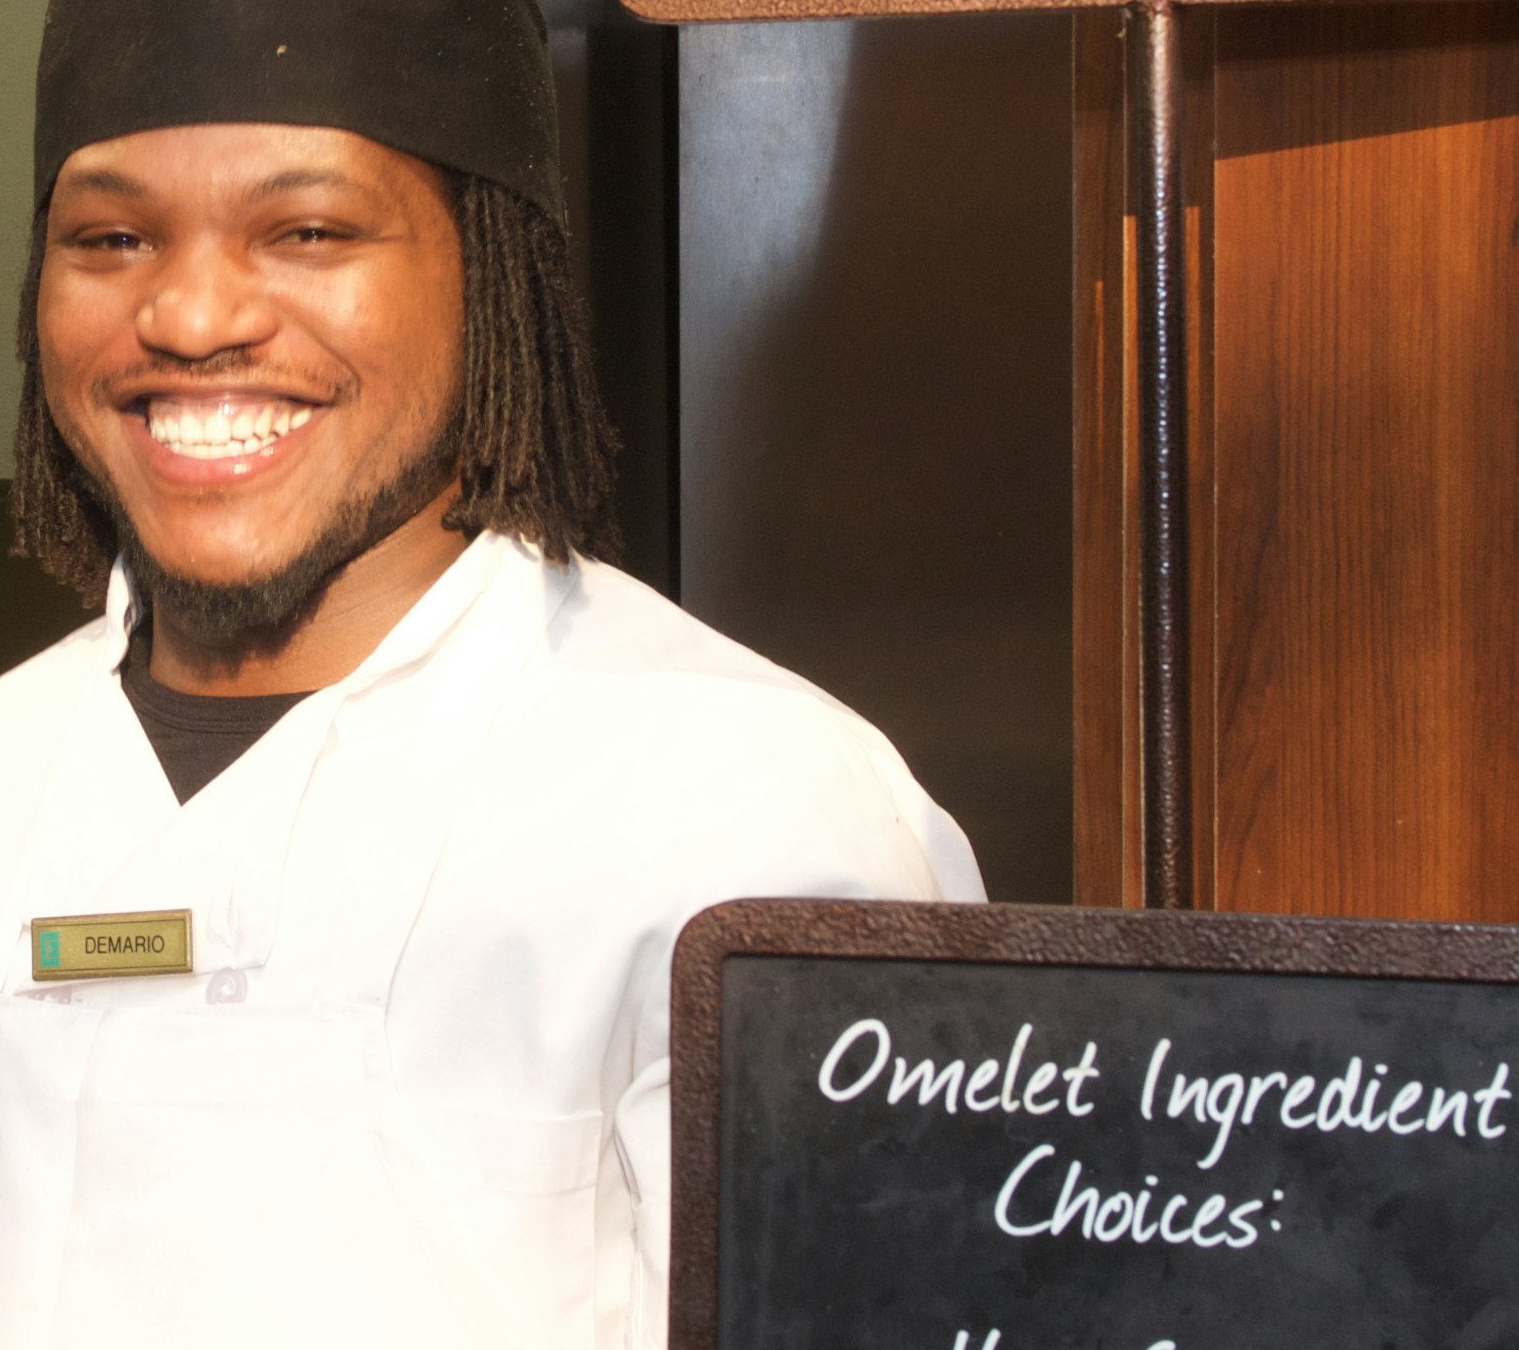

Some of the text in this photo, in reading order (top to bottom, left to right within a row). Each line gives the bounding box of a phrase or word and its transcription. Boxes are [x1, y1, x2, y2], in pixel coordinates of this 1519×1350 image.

[84, 934, 166, 955] DEMARIO
[816, 1017, 1513, 1171] Omelet Ingredient
[993, 1142, 1285, 1250] Choices:
